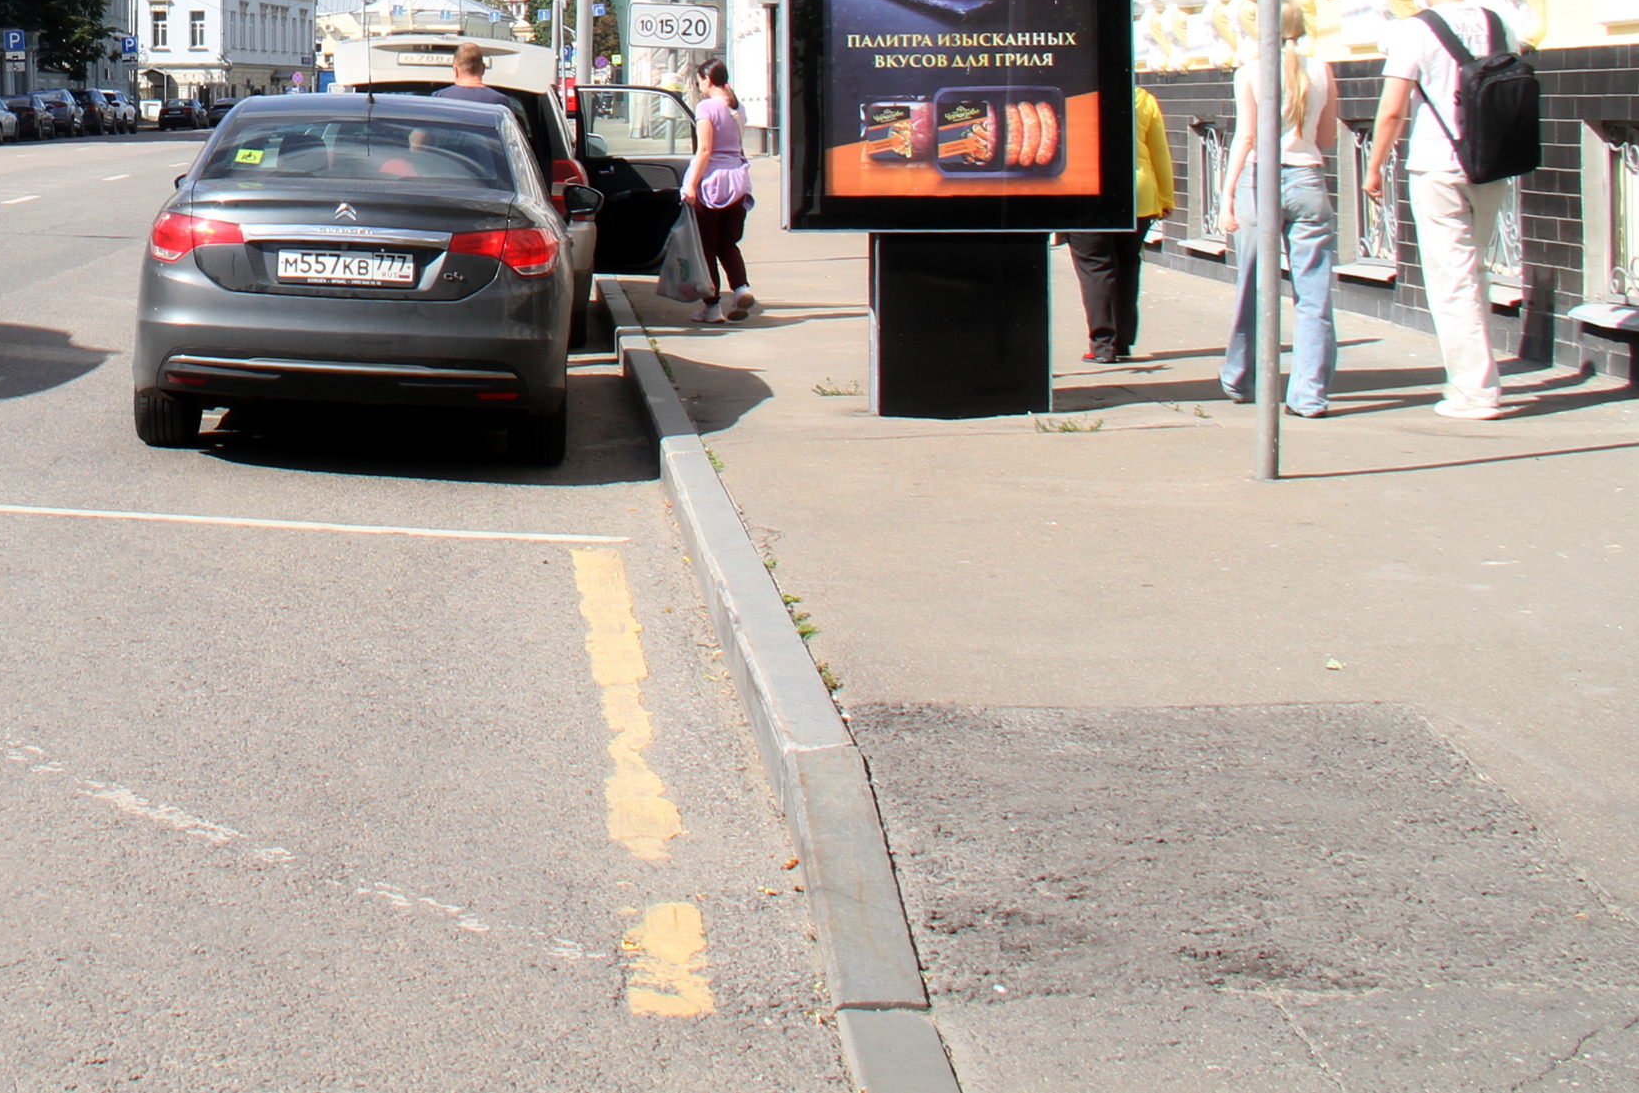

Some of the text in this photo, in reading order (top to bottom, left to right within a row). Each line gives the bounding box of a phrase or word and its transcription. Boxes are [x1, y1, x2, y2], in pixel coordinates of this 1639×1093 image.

[640, 19, 707, 36] 10 15 20
[9, 32, 20, 47] P
[846, 32, 1077, 48] ПАЛИТРА ИЗЫСКАННЫХ
[874, 53, 1054, 68] ВКУСОВ ДЛЯ ГРИЛЯ
